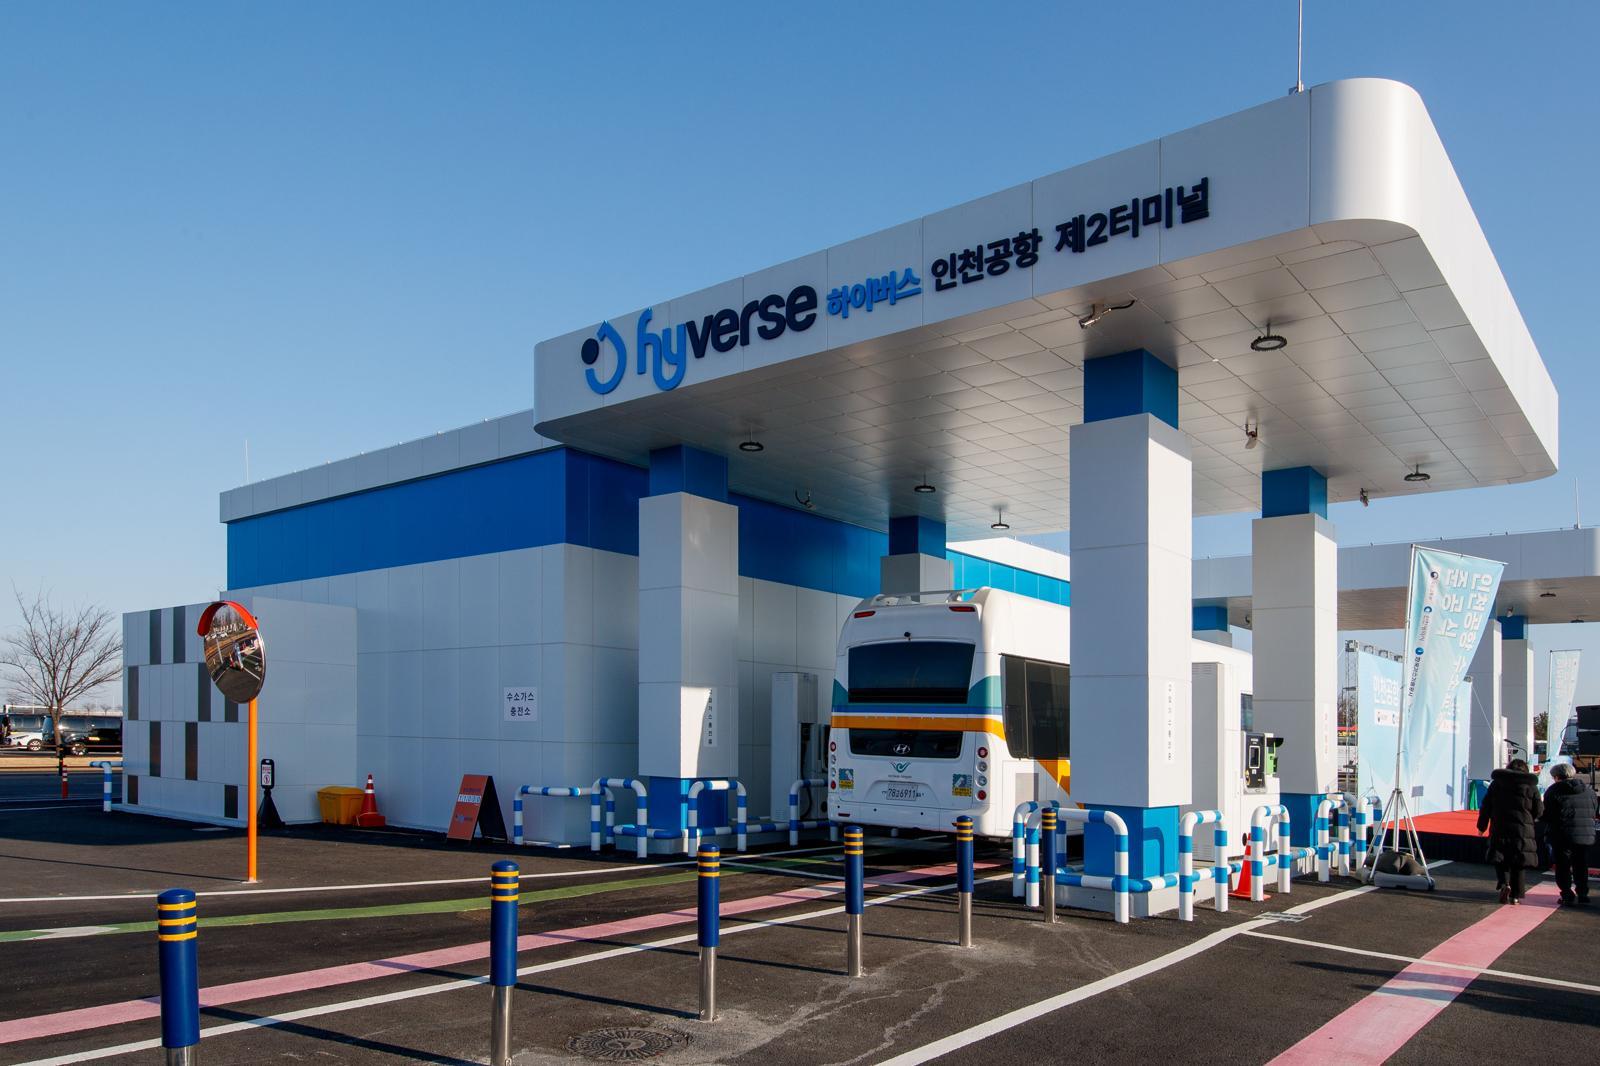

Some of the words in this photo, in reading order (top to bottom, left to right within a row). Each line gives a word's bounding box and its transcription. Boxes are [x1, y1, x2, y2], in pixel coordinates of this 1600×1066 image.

[931, 229, 1043, 291] 인천공항
[1055, 177, 1209, 252] 제2터미널
[826, 267, 921, 317] 하이버스
[637, 284, 818, 391] hyverse
[506, 692, 535, 702] 수소가스
[510, 706, 531, 717] 충전소
